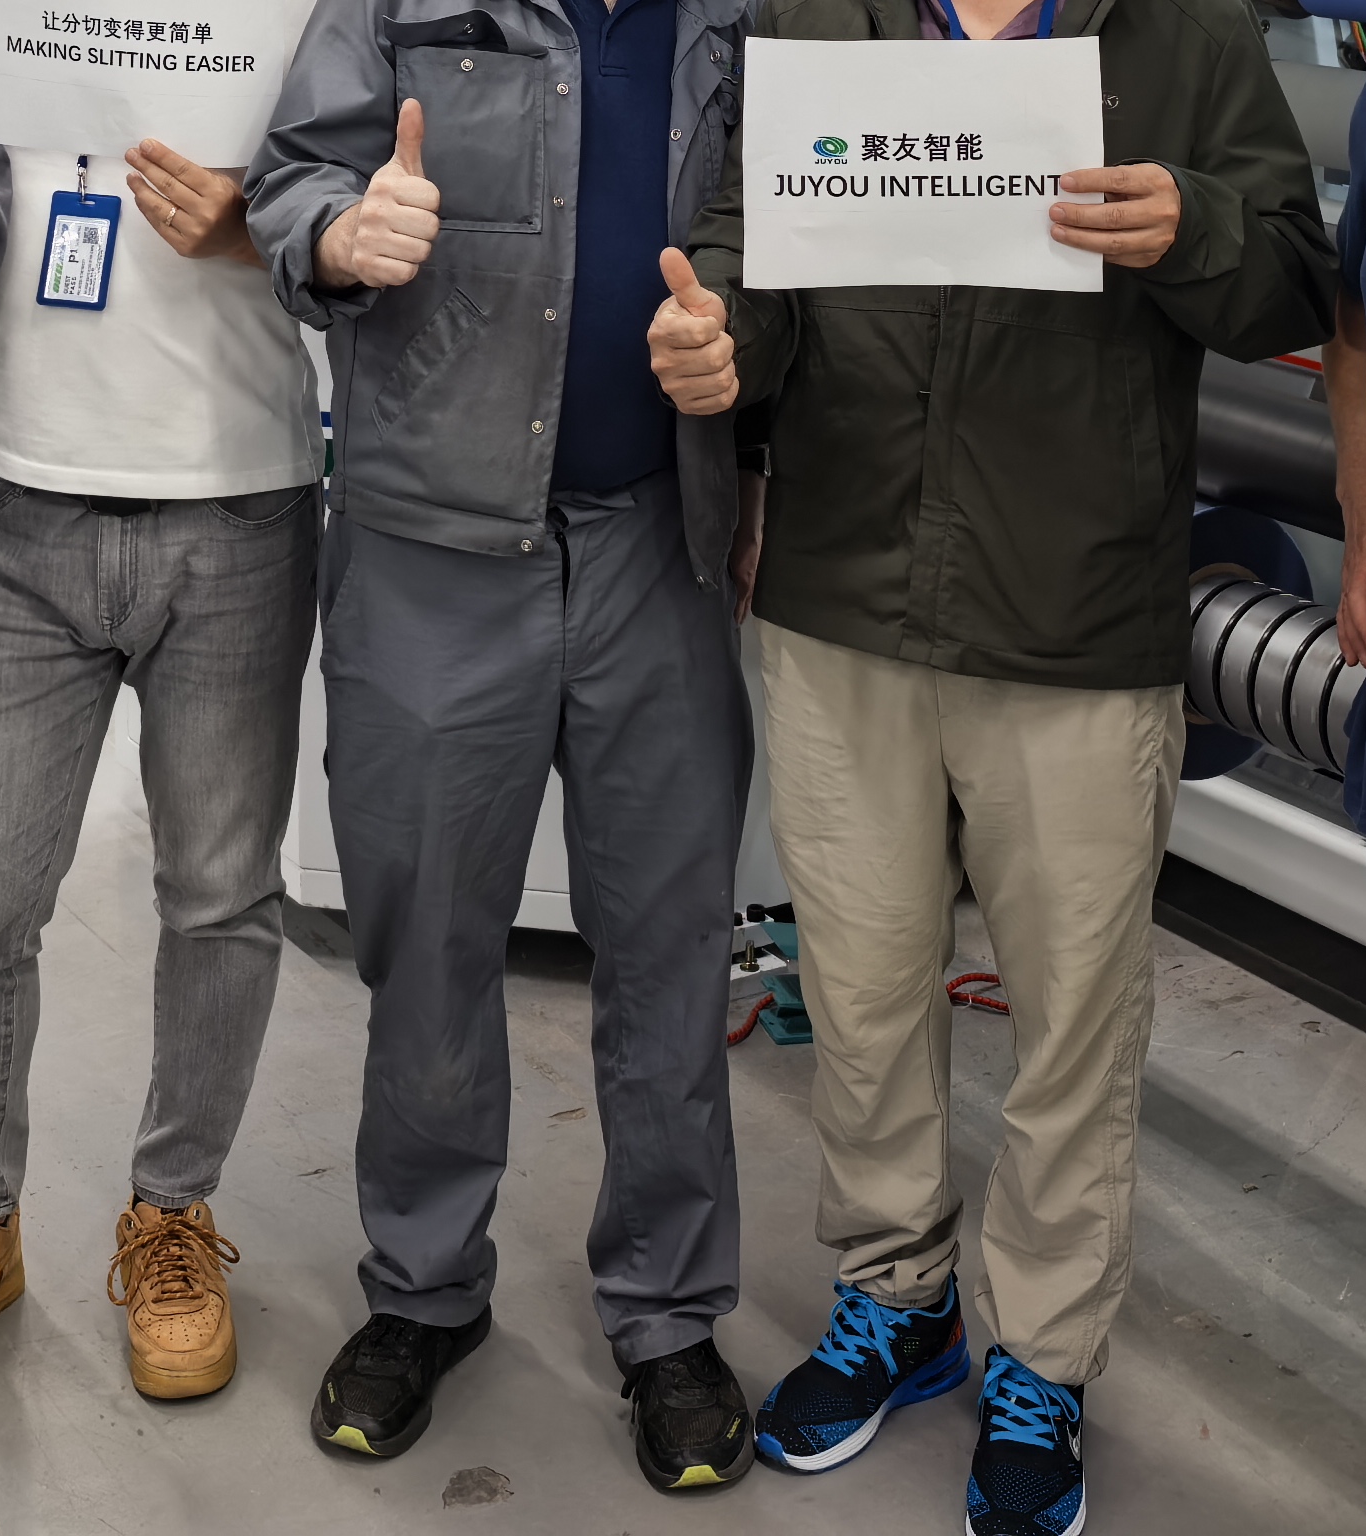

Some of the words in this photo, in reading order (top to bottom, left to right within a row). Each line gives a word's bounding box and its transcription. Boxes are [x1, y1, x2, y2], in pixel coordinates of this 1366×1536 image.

[42, 10, 213, 45] 让分切变得更简单
[6, 35, 82, 62] MAKING
[87, 47, 178, 71] SLITTING
[185, 55, 255, 72] EASIER
[861, 133, 984, 162] 聚友智能
[774, 174, 870, 198] JUYOU
[880, 174, 1061, 198] INTELLIGENT
